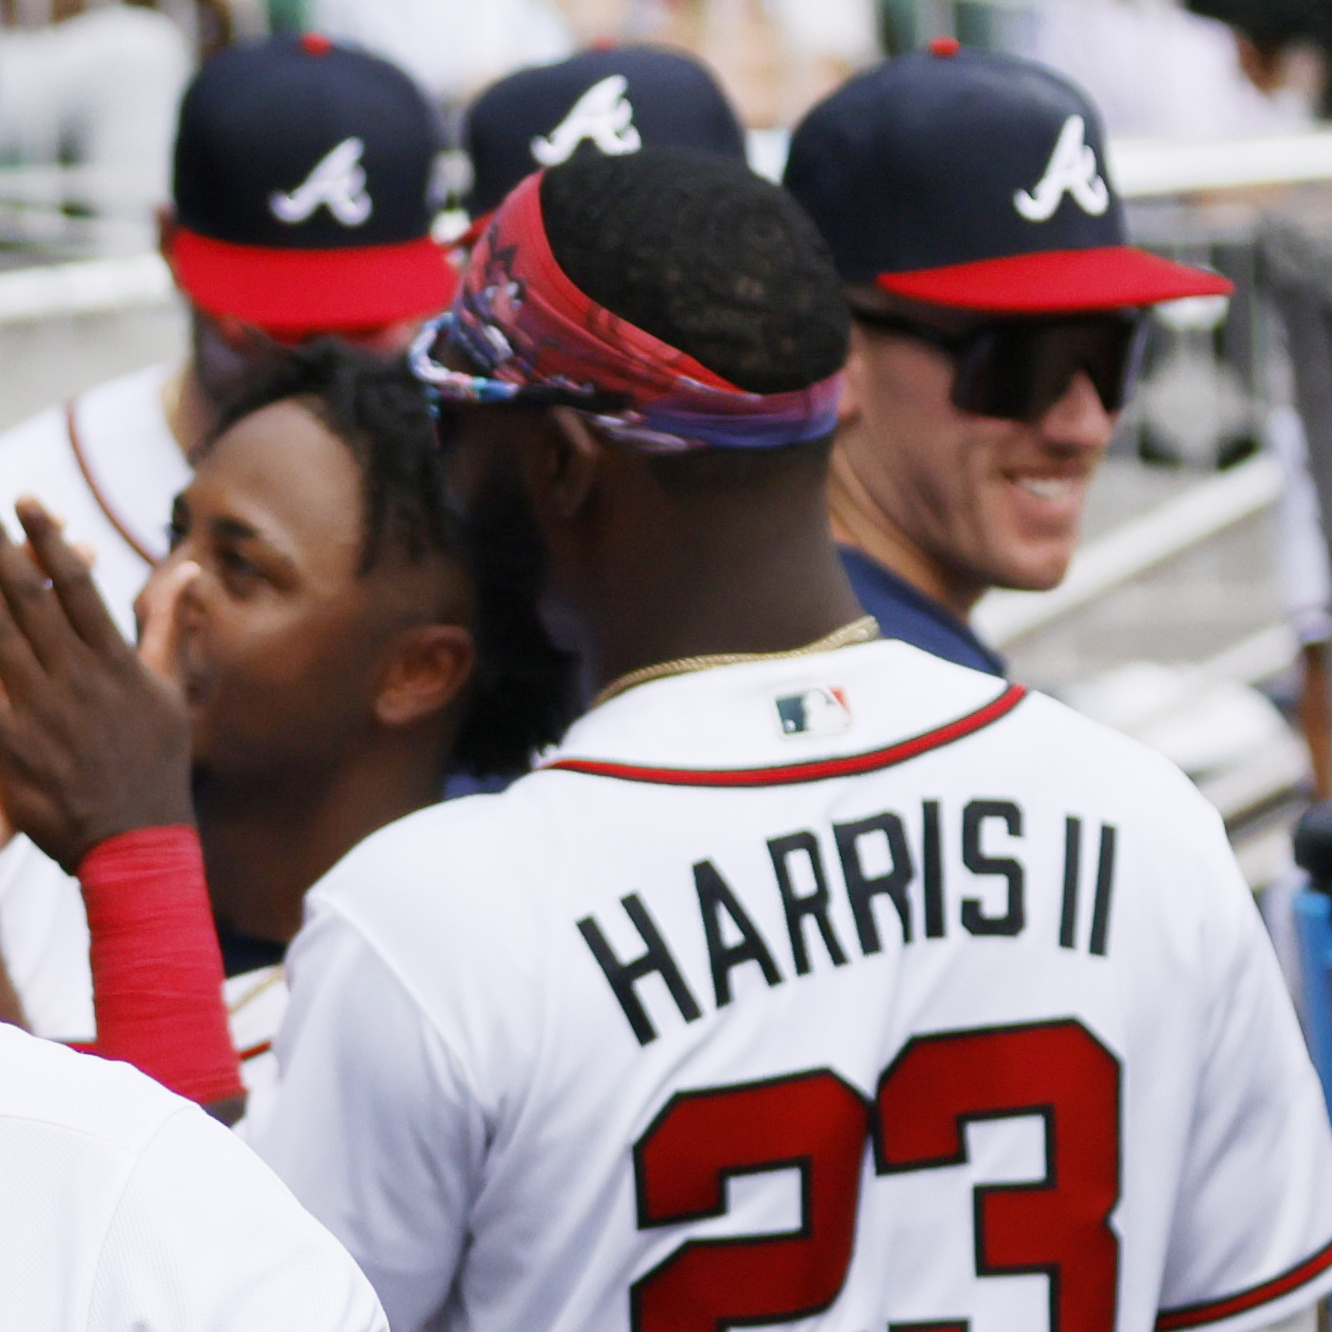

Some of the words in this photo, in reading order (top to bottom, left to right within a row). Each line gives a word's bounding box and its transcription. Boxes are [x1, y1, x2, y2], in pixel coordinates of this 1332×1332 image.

[1013, 113, 1110, 222] A
[575, 799, 1026, 1046] HARRIS
[1059, 817, 1117, 957] II
